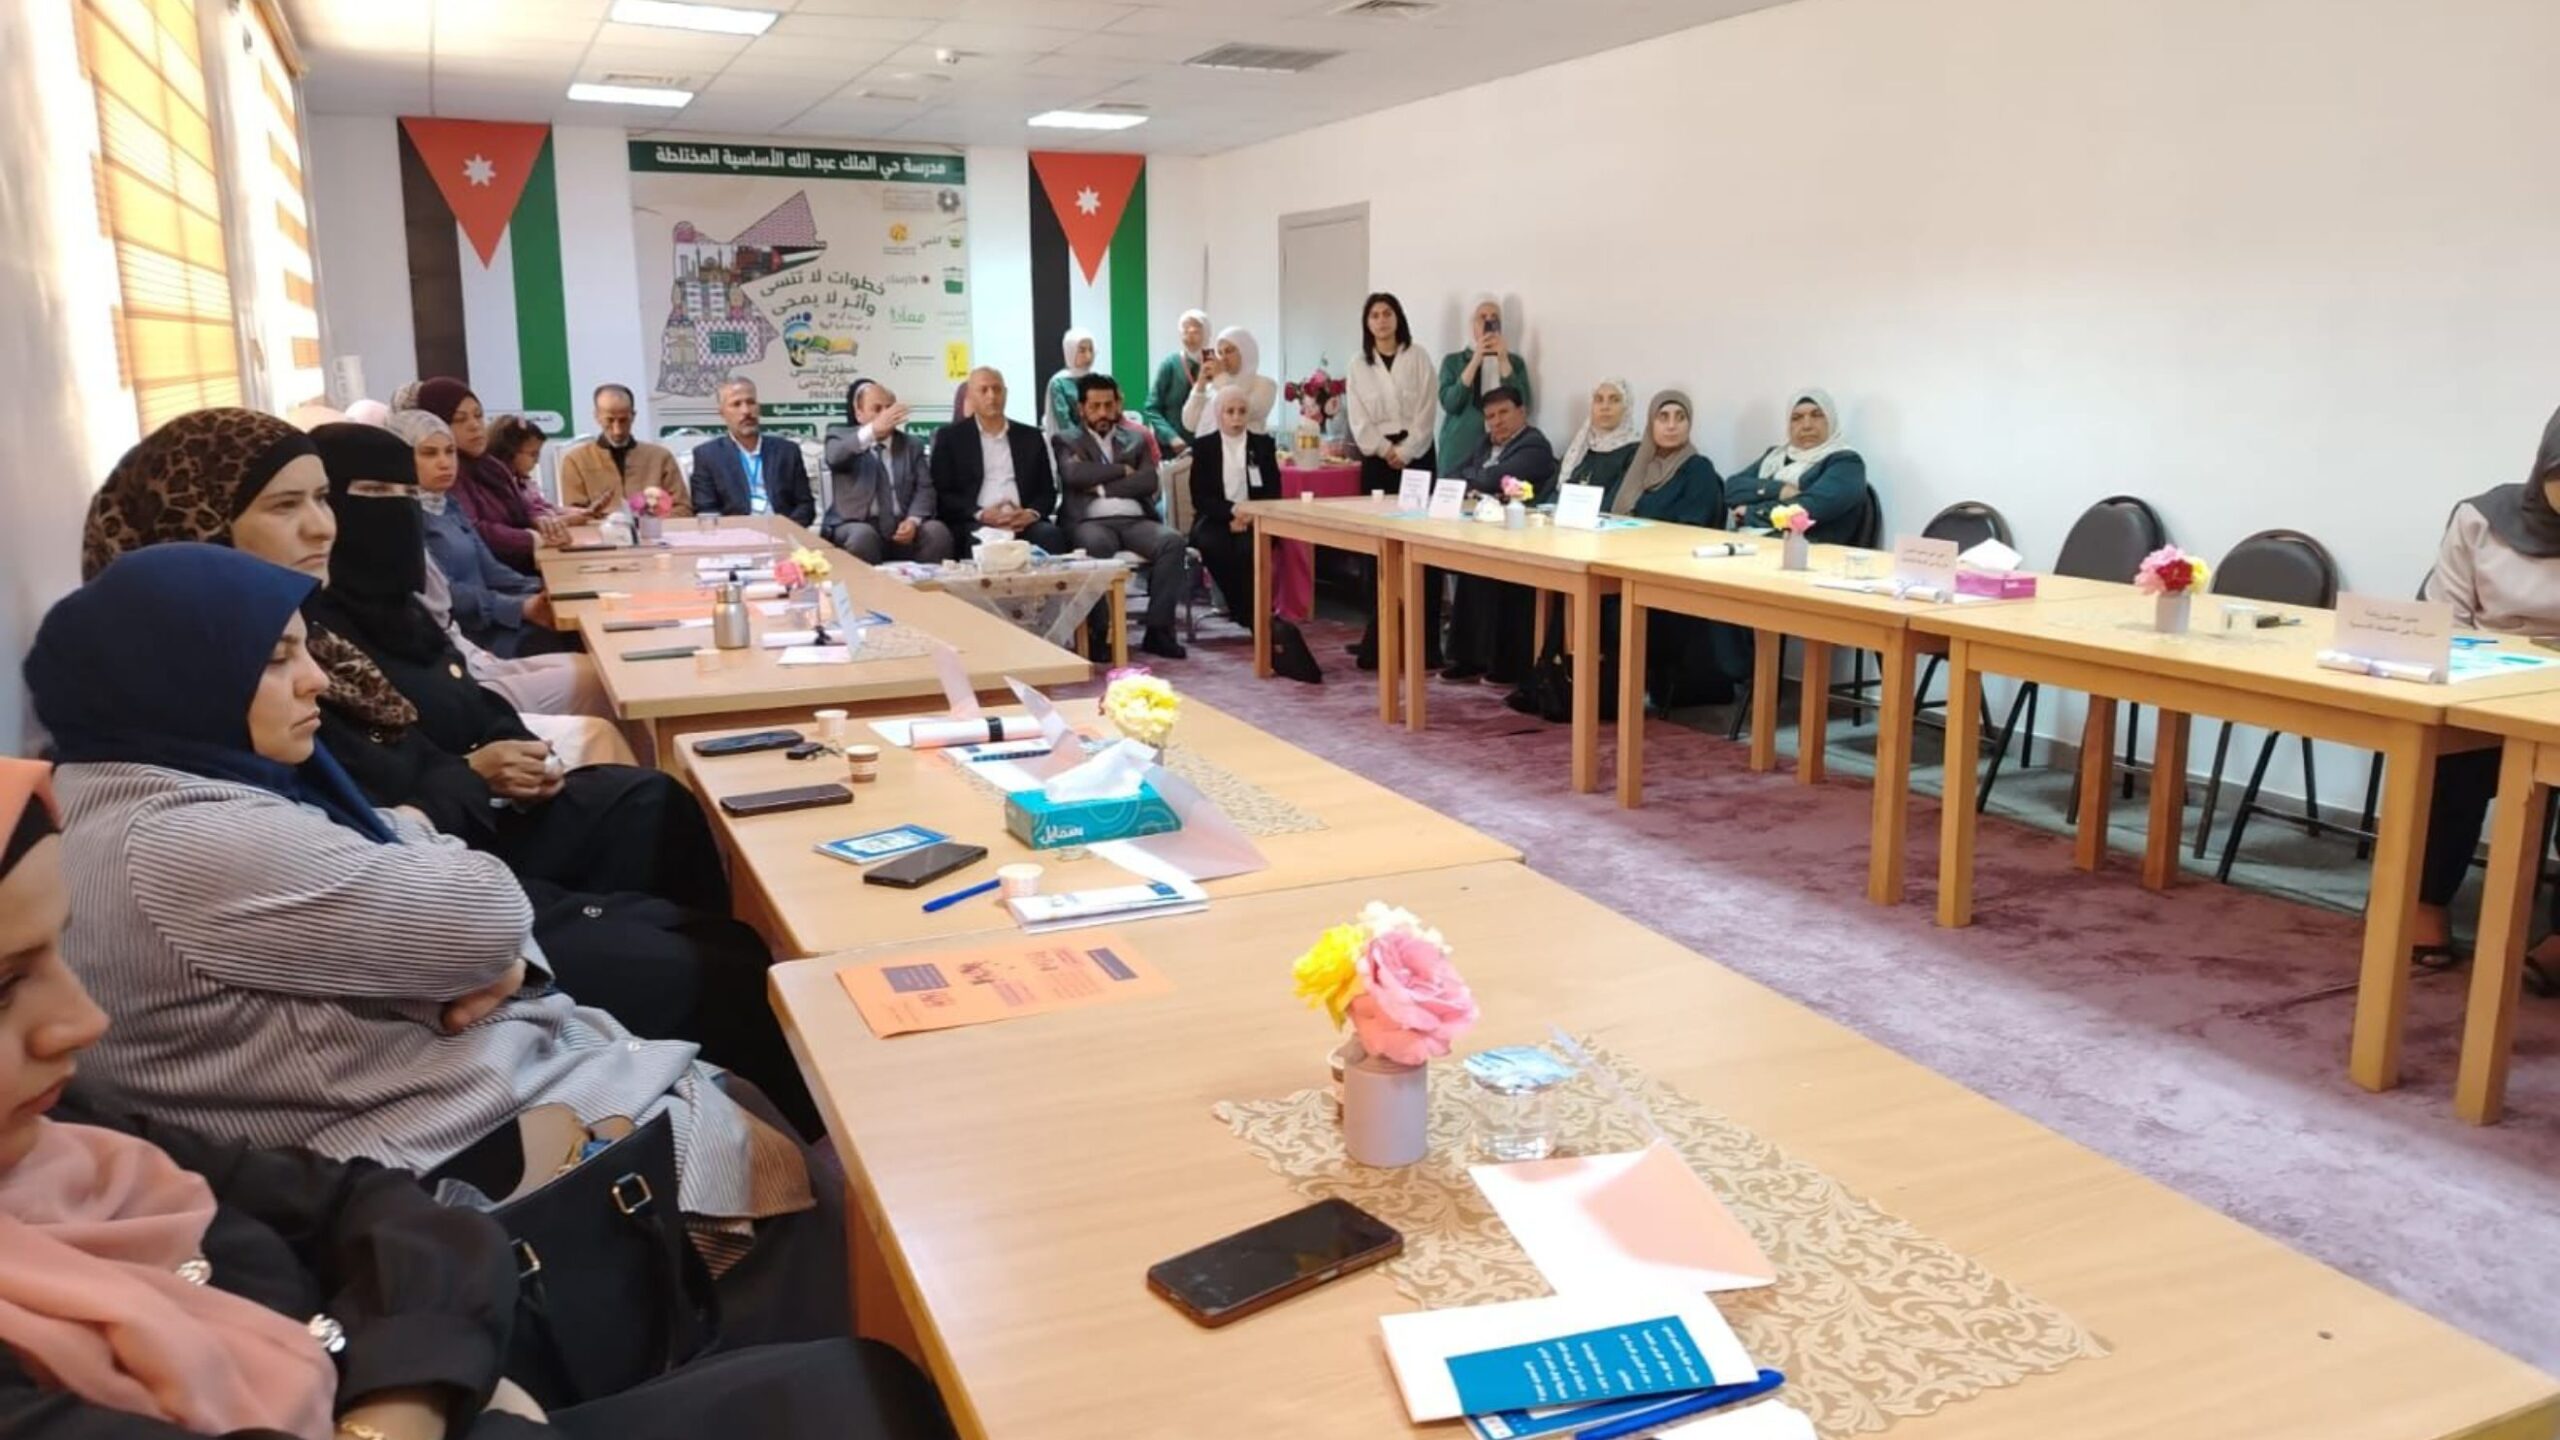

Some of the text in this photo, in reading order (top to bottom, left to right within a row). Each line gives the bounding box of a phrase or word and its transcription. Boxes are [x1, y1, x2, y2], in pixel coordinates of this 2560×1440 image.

[655, 145, 946, 180] مدرسة حي الملك عبد الله الأساسية المختلطة
[760, 269, 804, 298] تنسى
[809, 268, 822, 284] لا
[827, 271, 886, 296] خطوات
[771, 293, 819, 317] يمحى
[823, 289, 838, 304] لا
